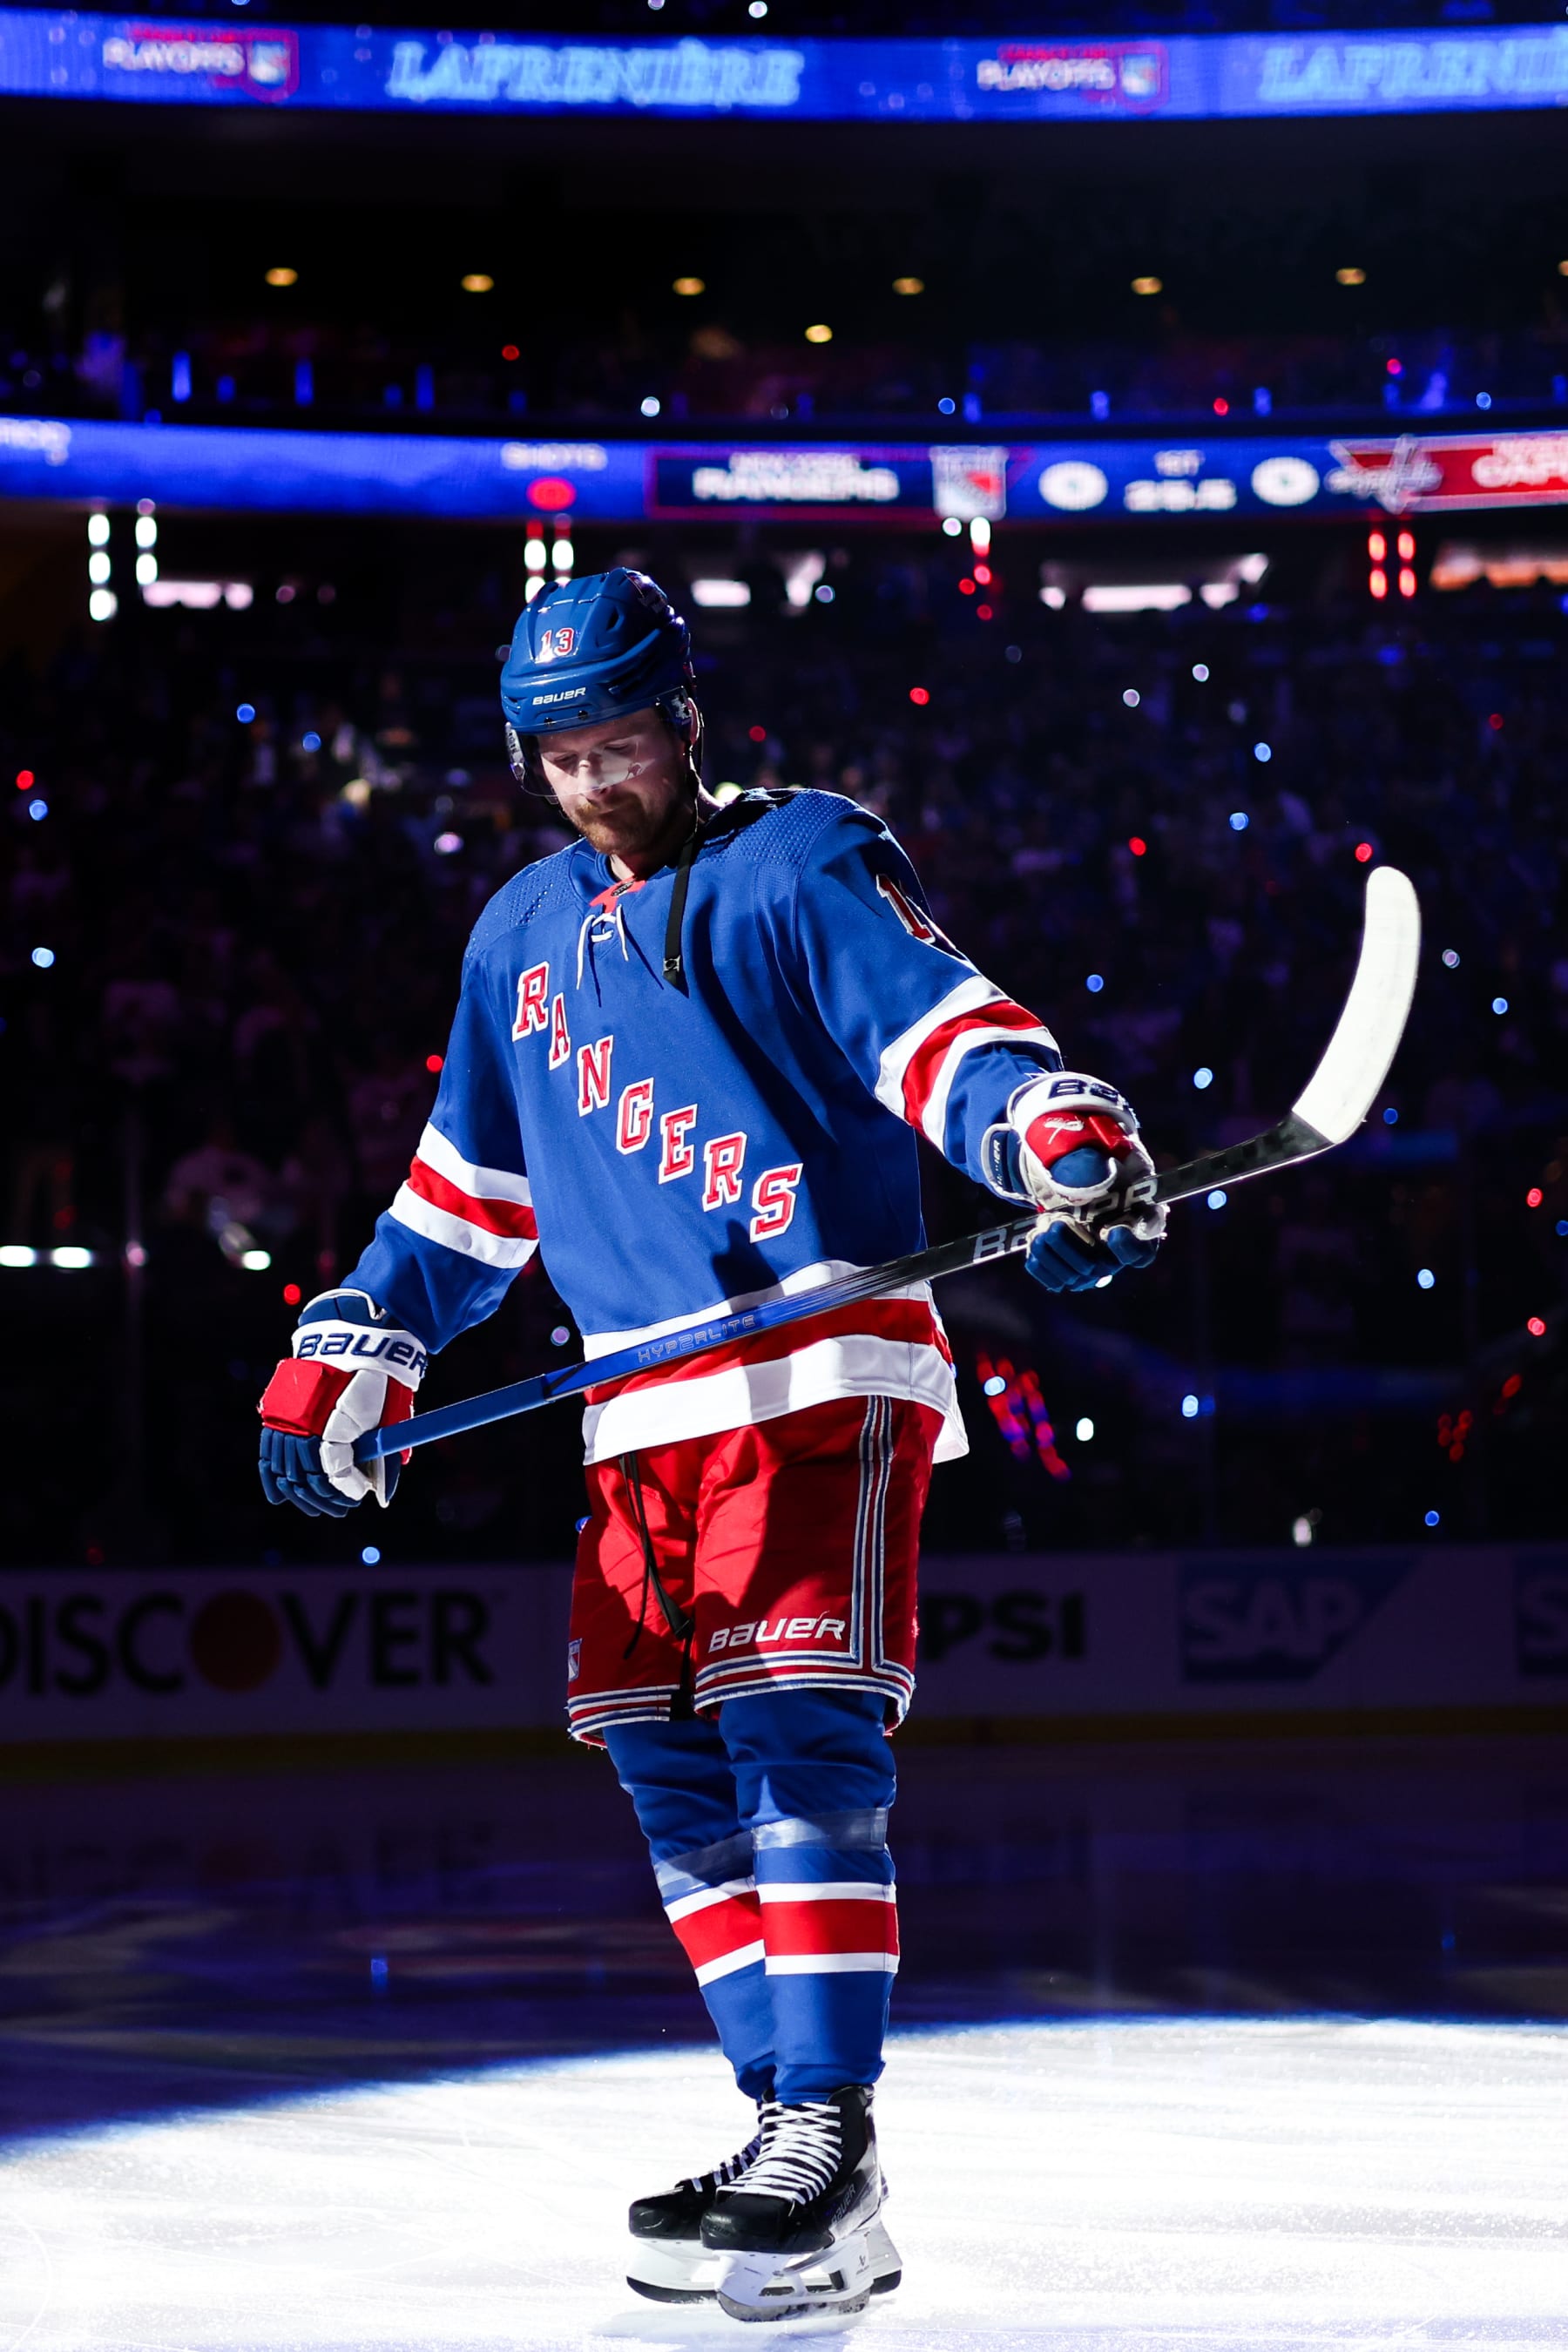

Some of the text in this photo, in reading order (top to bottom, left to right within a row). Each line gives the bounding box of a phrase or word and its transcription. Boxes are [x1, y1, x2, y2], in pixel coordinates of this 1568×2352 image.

[539, 627, 576, 657] 13
[511, 960, 804, 1244] RANGERS
[0, 1589, 497, 1696] ISCOVER
[919, 1591, 1087, 1663] PSI
[1186, 1576, 1364, 1660] SAP
